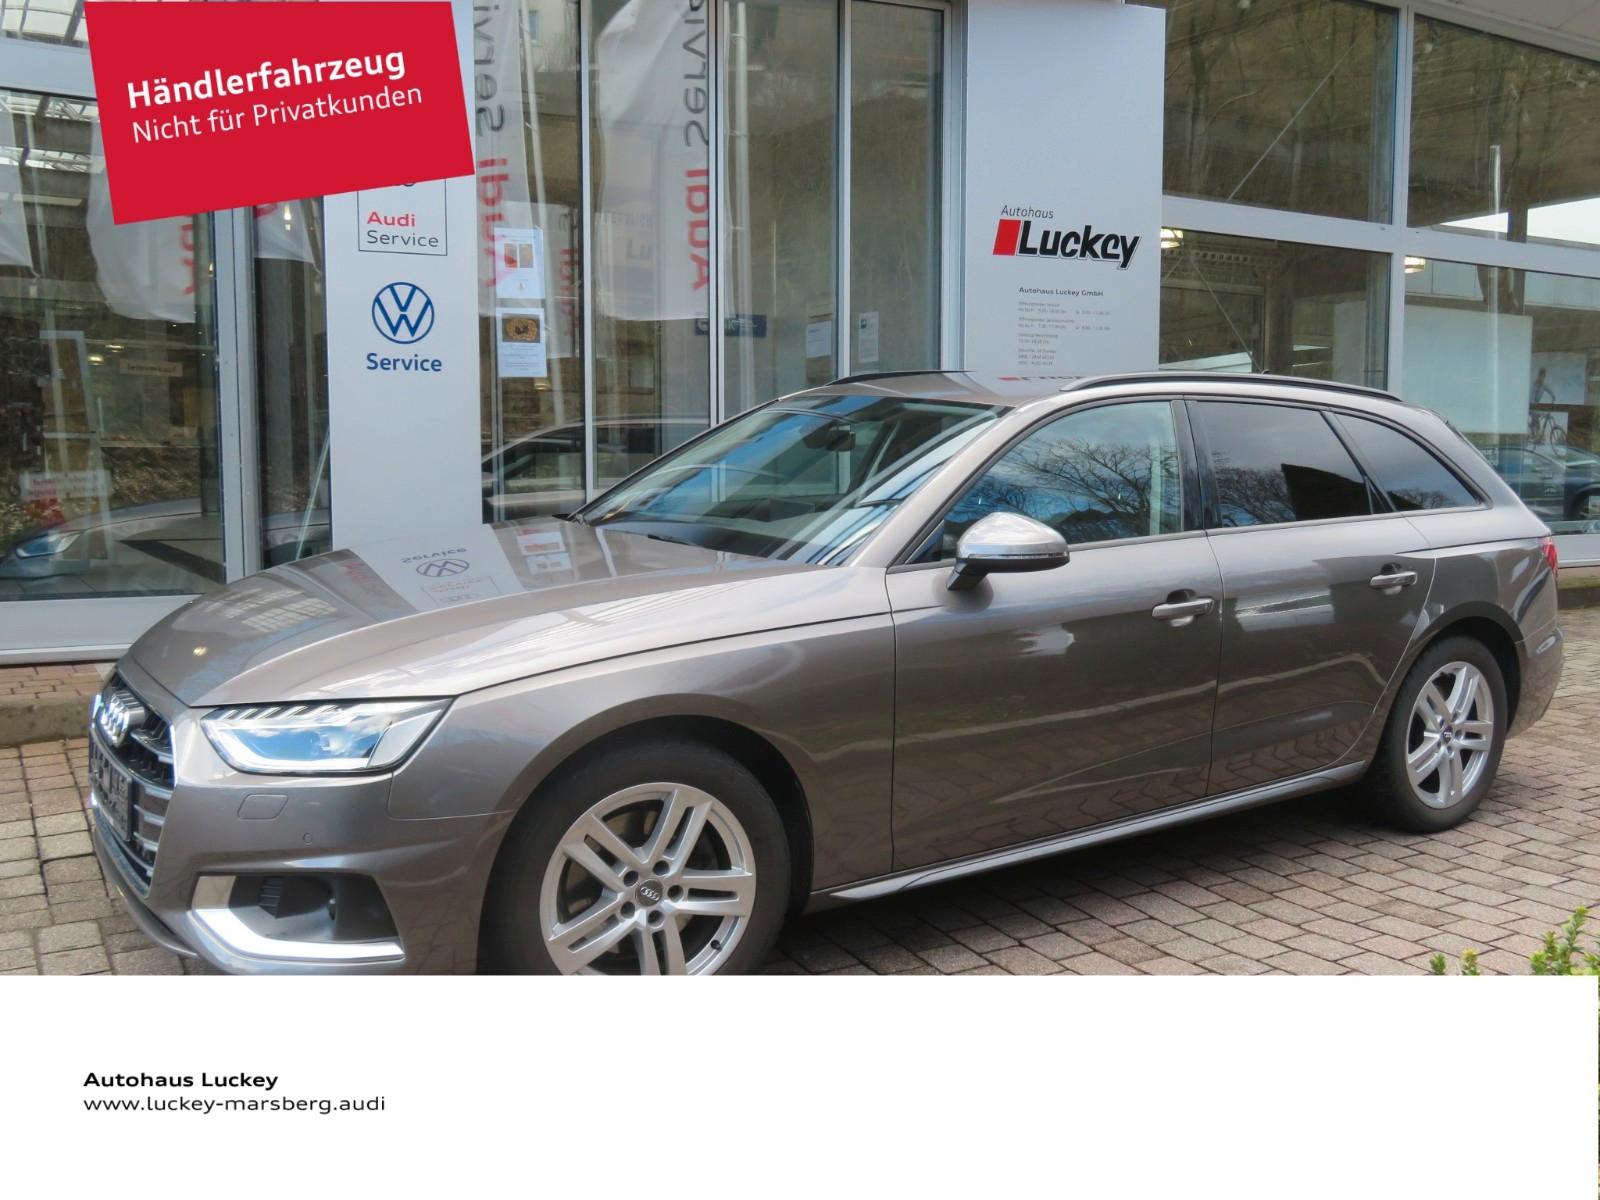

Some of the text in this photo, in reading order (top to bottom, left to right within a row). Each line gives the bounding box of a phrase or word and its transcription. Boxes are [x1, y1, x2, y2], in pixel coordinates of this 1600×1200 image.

[366, 211, 416, 228] Audi
[1001, 204, 1054, 219] Autohaus
[366, 230, 439, 248] Service
[1018, 220, 1141, 270] Luckey
[1018, 287, 1104, 297] Autohaus Luckey GmbH
[366, 352, 442, 372] Service
